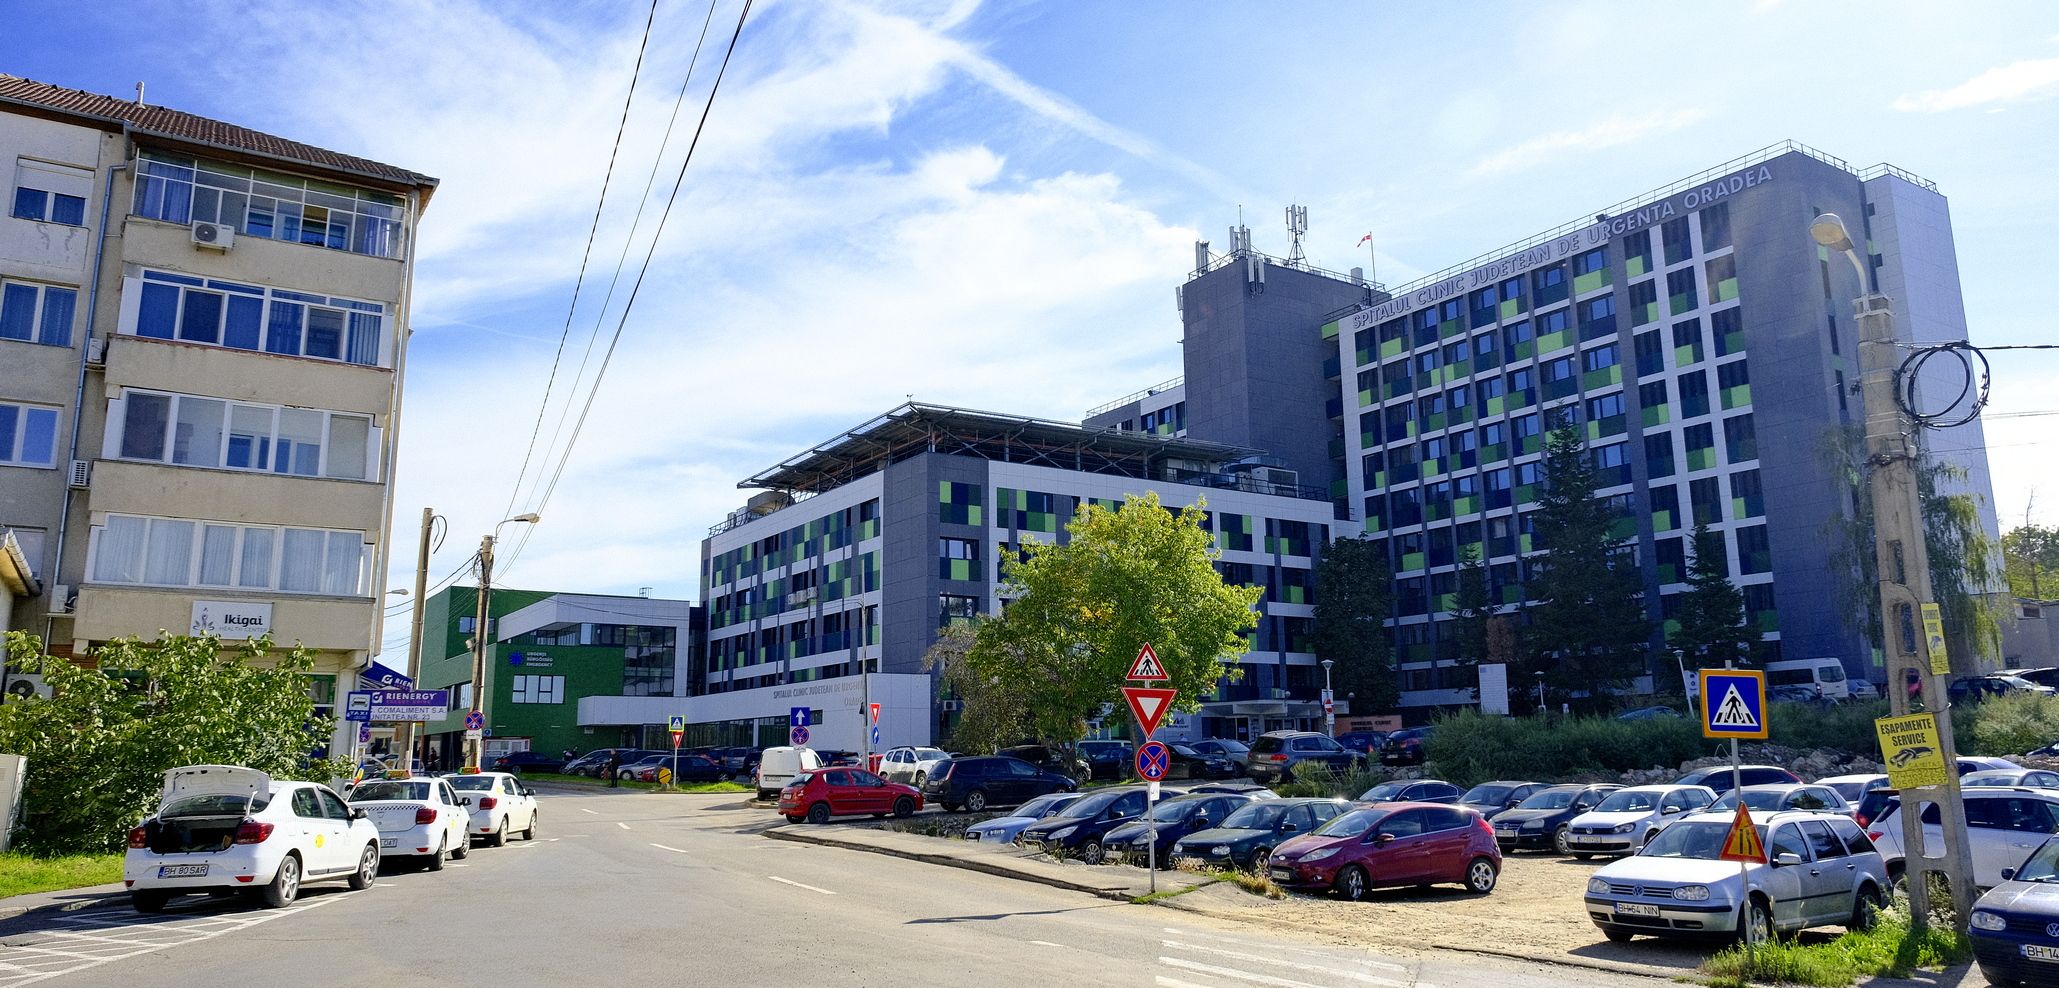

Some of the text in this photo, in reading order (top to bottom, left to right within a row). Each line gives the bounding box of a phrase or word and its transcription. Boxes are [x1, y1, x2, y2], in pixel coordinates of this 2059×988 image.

[1352, 166, 1773, 329] SPITALUL CLINIC JUDETEAN DE URGENTA ORADEA
[224, 614, 263, 627] Ikigai
[386, 692, 436, 700] RIENERGY
[1891, 733, 1926, 746] SERVICE
[164, 867, 176, 875] BH
[190, 866, 206, 874] SAR
[1618, 903, 1629, 912] BH
[1644, 906, 1658, 915] NIN
[2026, 945, 2044, 957] BH
